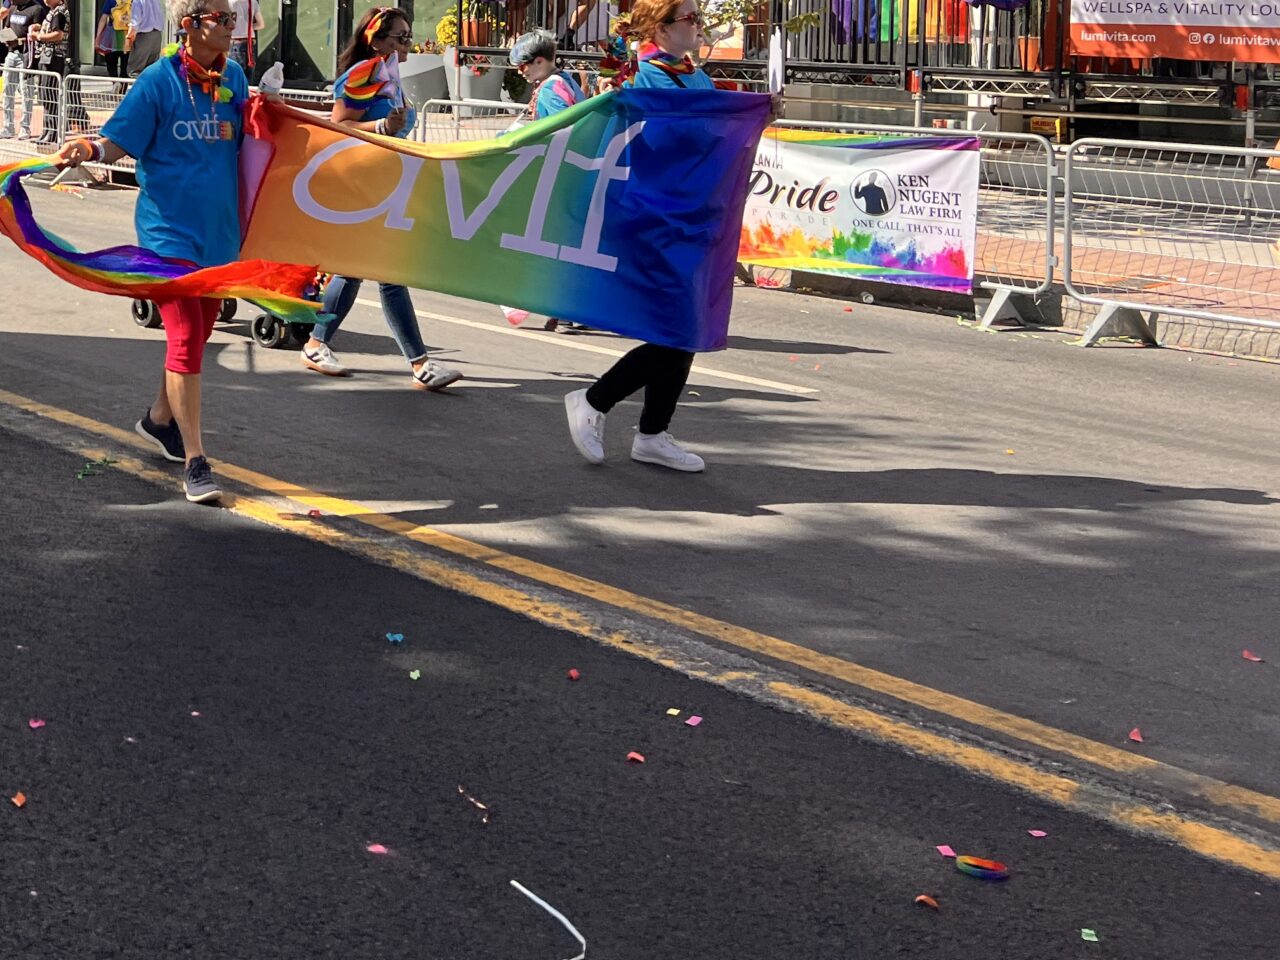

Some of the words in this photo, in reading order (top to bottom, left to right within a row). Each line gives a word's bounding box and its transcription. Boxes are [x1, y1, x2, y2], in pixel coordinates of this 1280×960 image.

[1083, 1, 1153, 14] WELLSPA
[1158, 2, 1169, 14] &
[1173, 2, 1246, 16] VITALITY
[1081, 30, 1156, 43] lumivita.com
[897, 174, 930, 188] KEN
[293, 121, 646, 272] avlf
[745, 170, 839, 214] Pride
[898, 189, 962, 206] NUGENT
[752, 208, 830, 226] PARADE
[900, 204, 925, 216] LAW
[929, 208, 962, 220] FIRM
[852, 218, 875, 229] ONE
[907, 224, 943, 235] THAT'S
[943, 228, 963, 238] ALL
